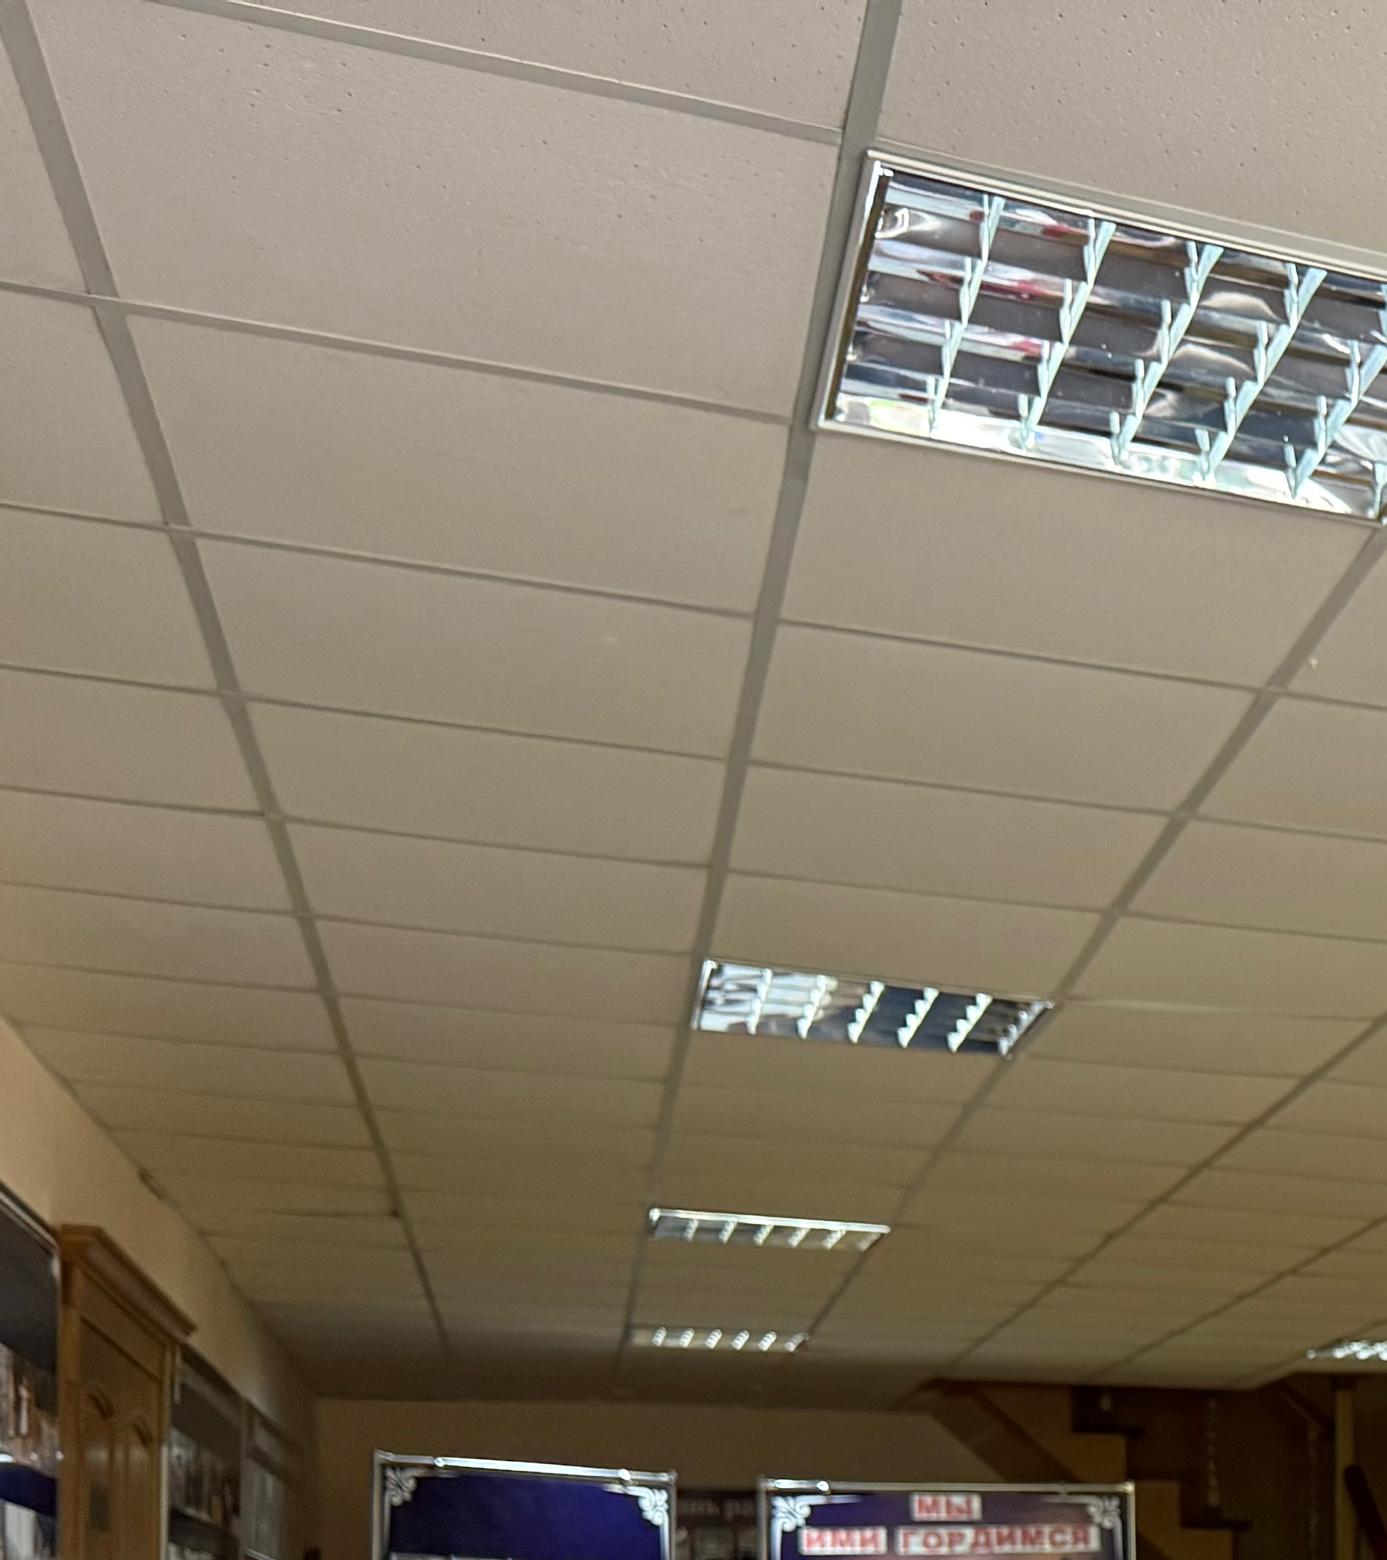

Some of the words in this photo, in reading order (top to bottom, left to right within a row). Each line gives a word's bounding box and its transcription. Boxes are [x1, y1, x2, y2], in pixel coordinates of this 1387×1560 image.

[916, 1495, 974, 1521] МЫ
[804, 1529, 880, 1550] ИМИ
[902, 1524, 1091, 1553] ГОРДИМСЯ
